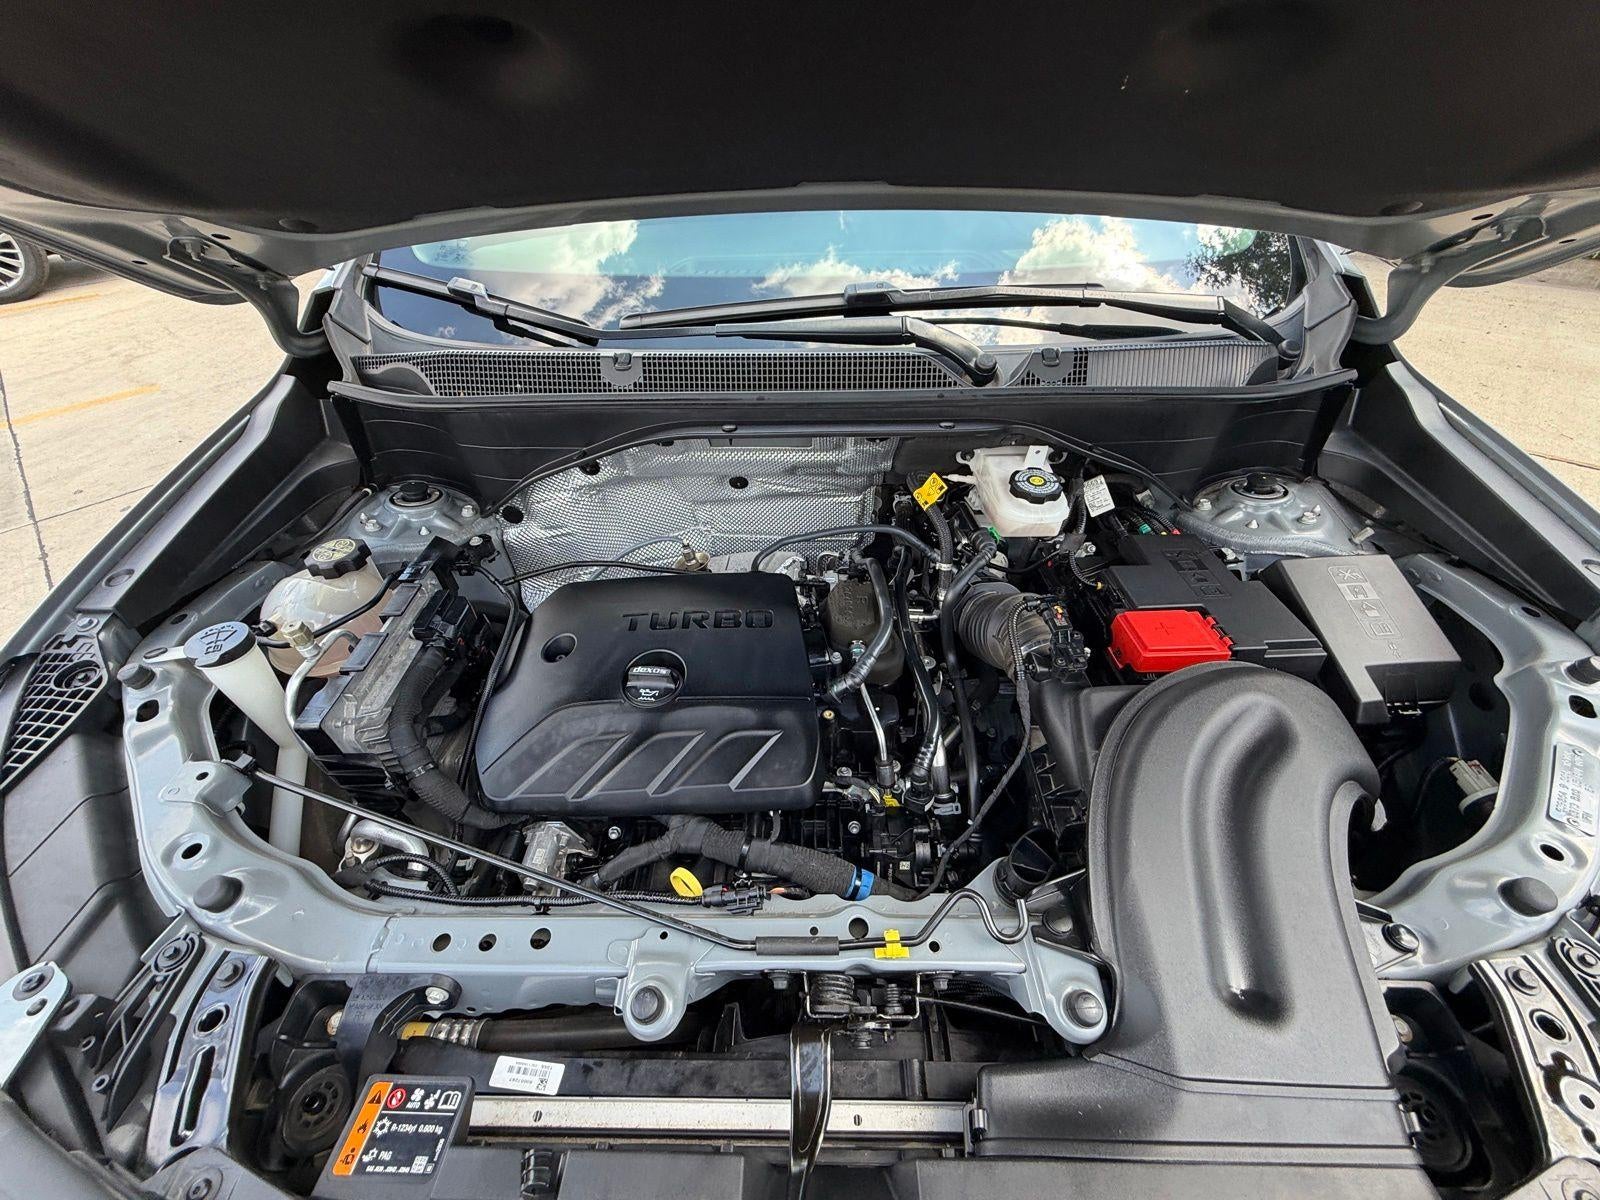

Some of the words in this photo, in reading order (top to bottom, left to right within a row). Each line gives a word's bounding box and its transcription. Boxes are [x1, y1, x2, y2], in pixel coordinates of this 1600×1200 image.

[622, 608, 775, 632] TURBO
[434, 1125, 443, 1134] kg
[378, 1151, 392, 1160] PAG
